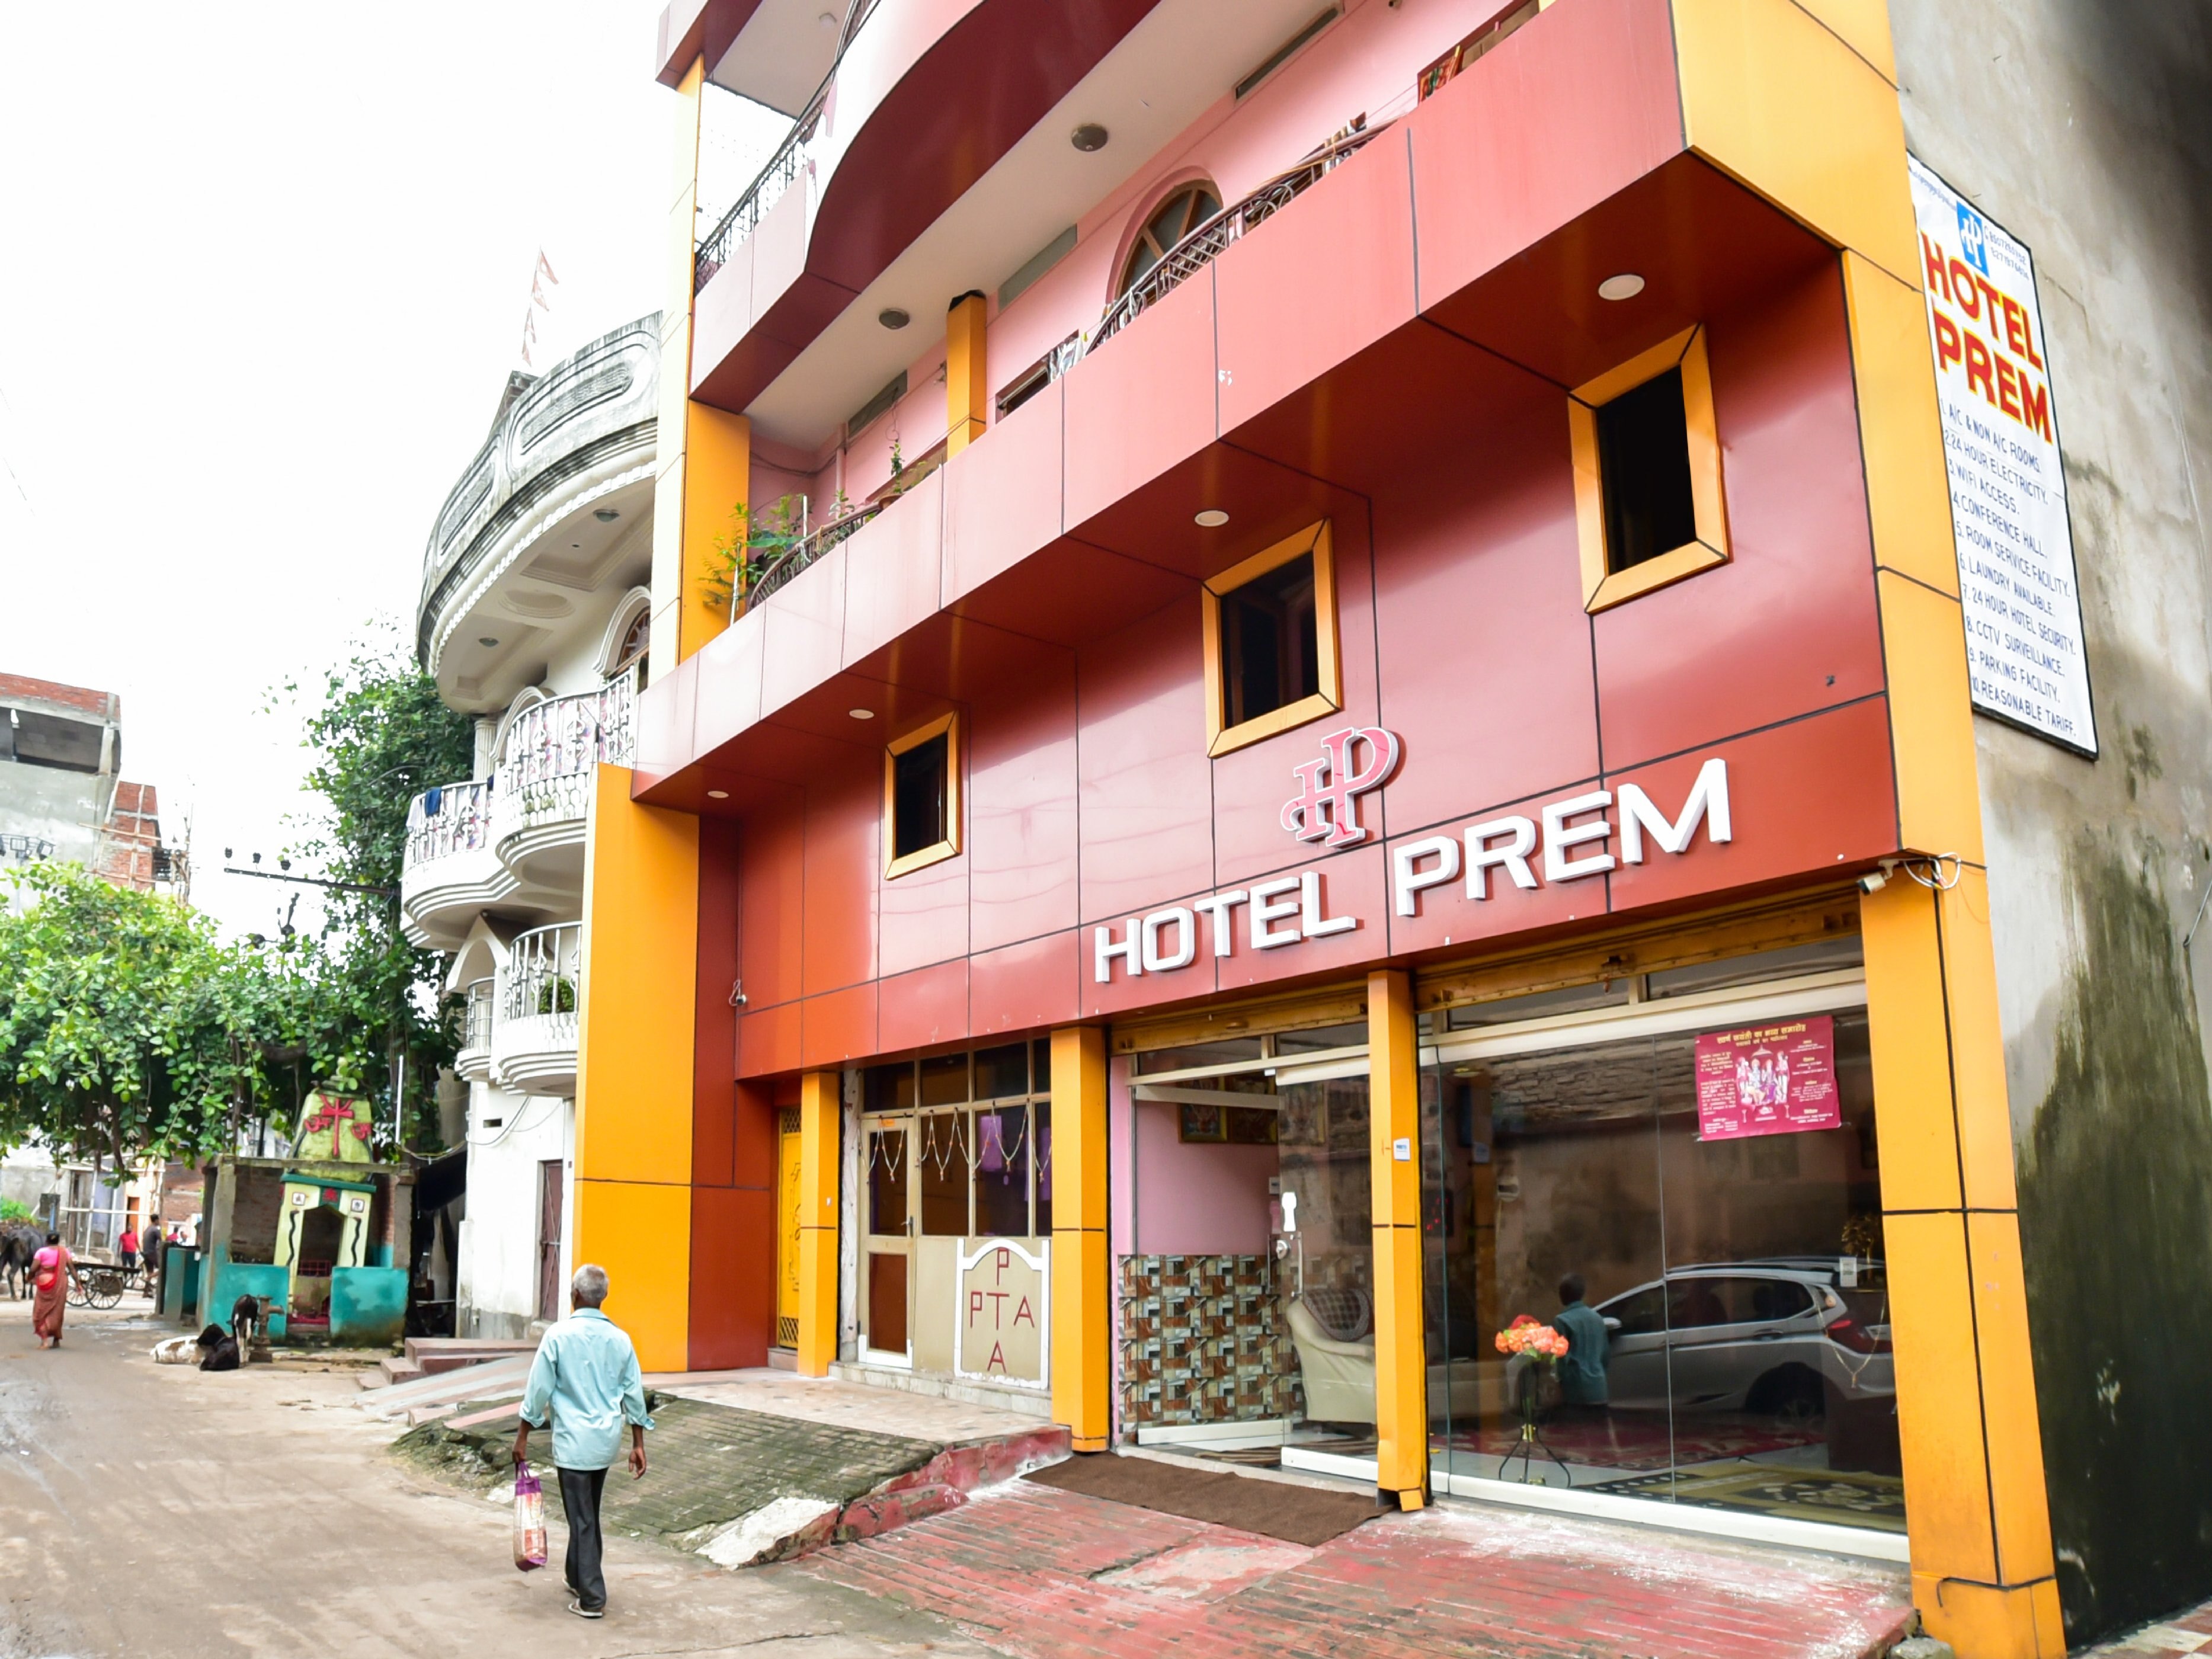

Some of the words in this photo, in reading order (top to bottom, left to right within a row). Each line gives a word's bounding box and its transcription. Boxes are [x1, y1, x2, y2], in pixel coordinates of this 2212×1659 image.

[1920, 229, 2043, 373] HOTEL
[1933, 306, 2053, 446] PREM
[1973, 418, 1991, 443] NON
[1956, 463, 1977, 488] WIFI
[1964, 441, 1989, 469] HOUR
[1961, 495, 2020, 543] CONFERENCE
[1965, 525, 1993, 554] ROOM
[1995, 541, 2031, 577] SERVICE
[1968, 556, 2010, 591] LAUNDRY
[1972, 587, 1983, 606] 24
[1984, 592, 2009, 619] HOUR
[2011, 606, 2036, 635] HOTEL
[1977, 620, 2000, 646] CCTV
[1980, 650, 2017, 682] PARKING
[1981, 680, 2042, 722] REASONABLE
[1094, 870, 1356, 984] HOTEL
[1393, 757, 1732, 917] PREM
